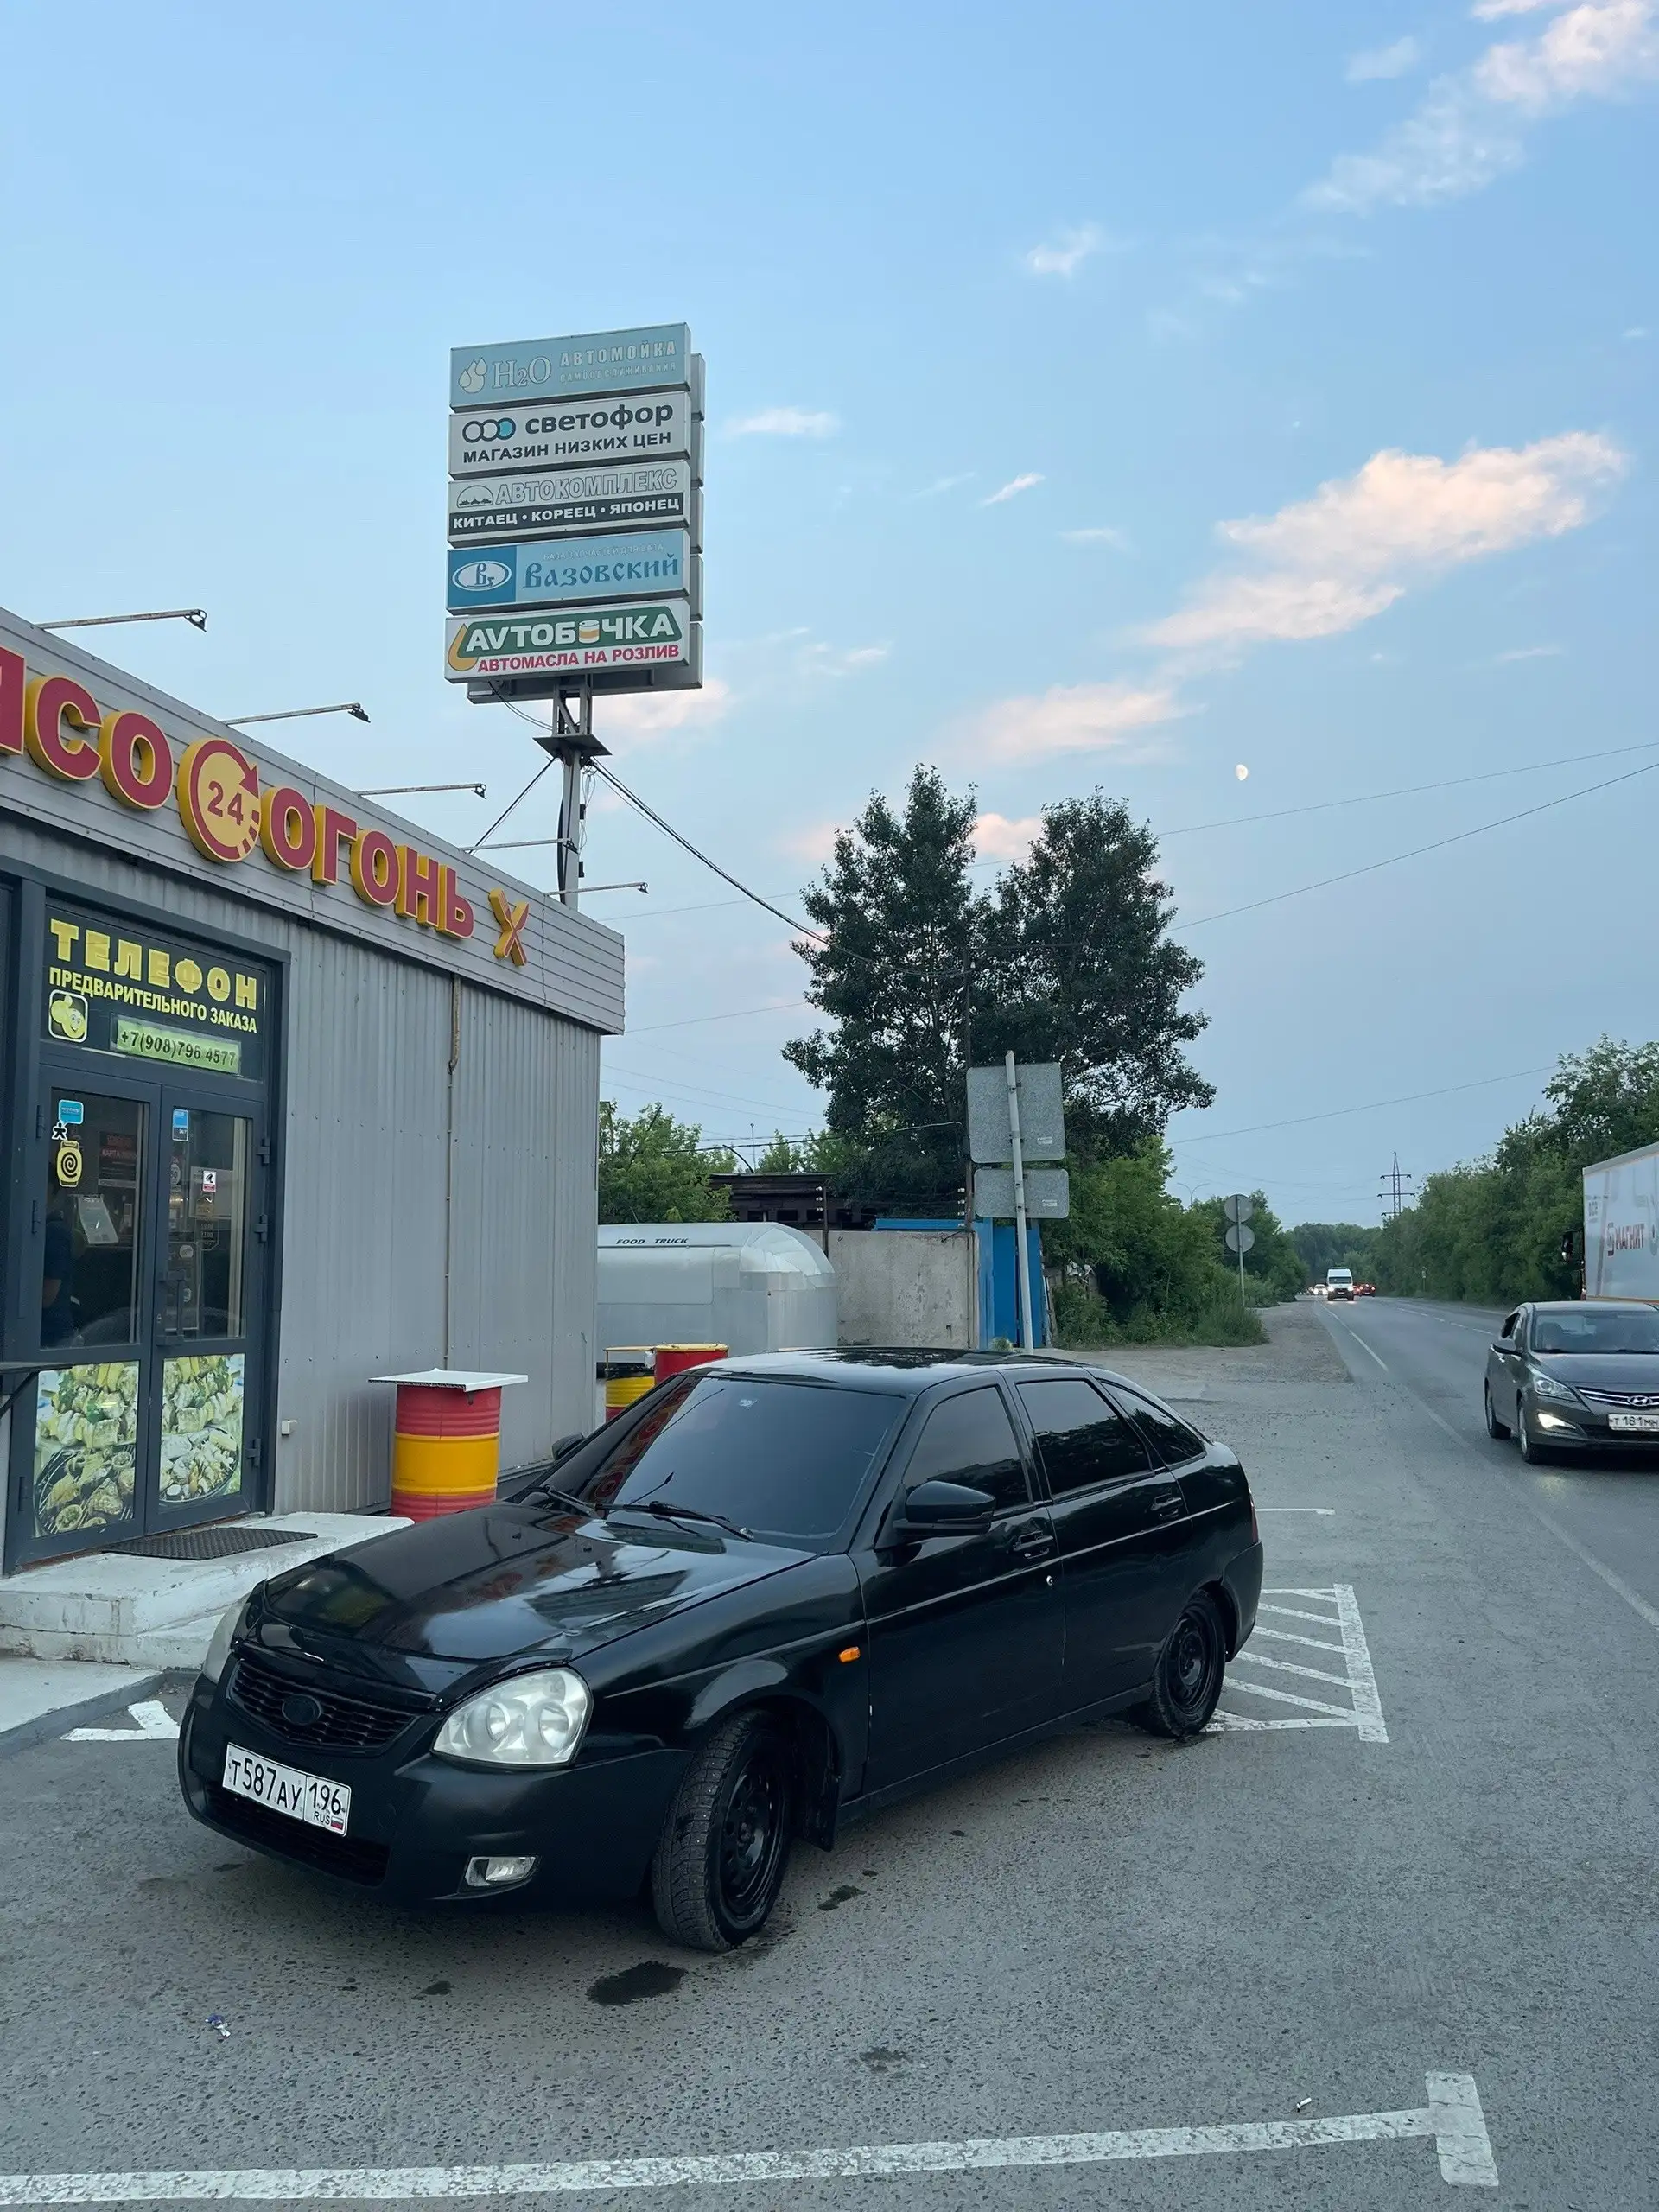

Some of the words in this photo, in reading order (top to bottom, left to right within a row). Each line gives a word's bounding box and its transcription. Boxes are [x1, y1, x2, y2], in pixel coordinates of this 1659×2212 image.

[560, 340, 677, 367] АВТОМОЙКА
[493, 355, 552, 389] H2O
[525, 404, 674, 435] светофор
[463, 443, 549, 463] МАГАЗИН
[555, 435, 628, 455] НИЗКИХ
[633, 432, 671, 448] ЦЕН
[495, 467, 677, 505] АВТОКОМПЛЕКС
[453, 512, 518, 529] КИТАЕЦ
[531, 505, 596, 522] КОРЕЕЦ
[609, 498, 680, 515] ЯПОНЕЦ
[523, 553, 679, 588] Вазовский
[478, 652, 579, 673] АВТОМАСЛА
[584, 649, 607, 664] НА
[613, 644, 679, 663] РОЗЛИВ
[207, 780, 243, 826] 24
[261, 785, 474, 939] ОГОНЬ
[50, 918, 257, 1011] ТЕЛЕФОН
[49, 967, 207, 1021] ПРЕДВАРИТЕЛЬНОГО
[210, 1006, 257, 1033] ЗАКАЗА
[205, 1048, 236, 1066] 4577
[232, 1757, 302, 1811] Т587АУ
[309, 1782, 341, 1815] 196
[313, 1811, 331, 1826] RUS
